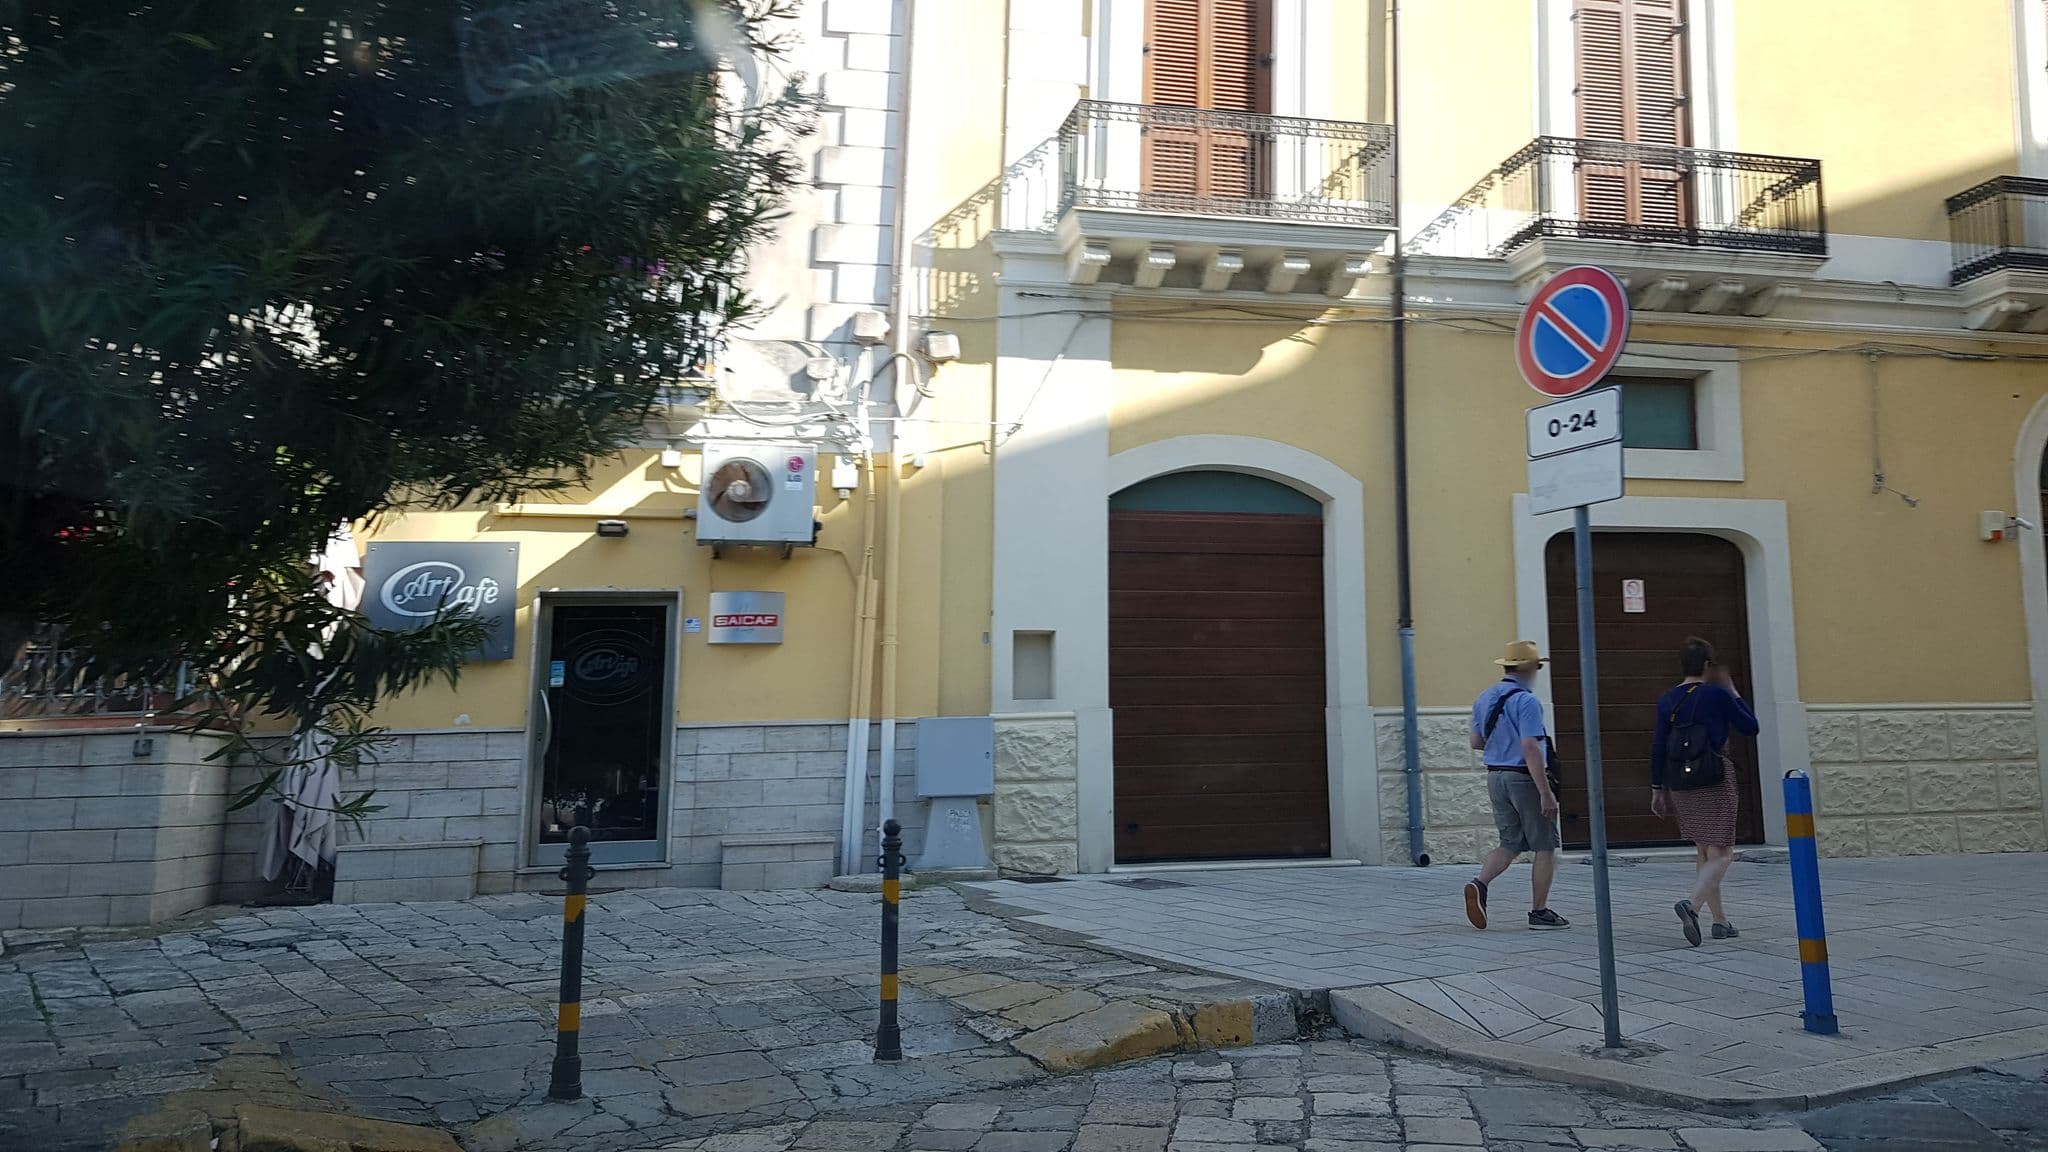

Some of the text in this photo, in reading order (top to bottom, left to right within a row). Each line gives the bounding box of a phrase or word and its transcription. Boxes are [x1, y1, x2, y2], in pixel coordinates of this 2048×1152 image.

[1548, 409, 1597, 437] 0-24
[787, 474, 803, 483] LG
[393, 571, 453, 605] Art
[715, 615, 777, 626] SAICAF
